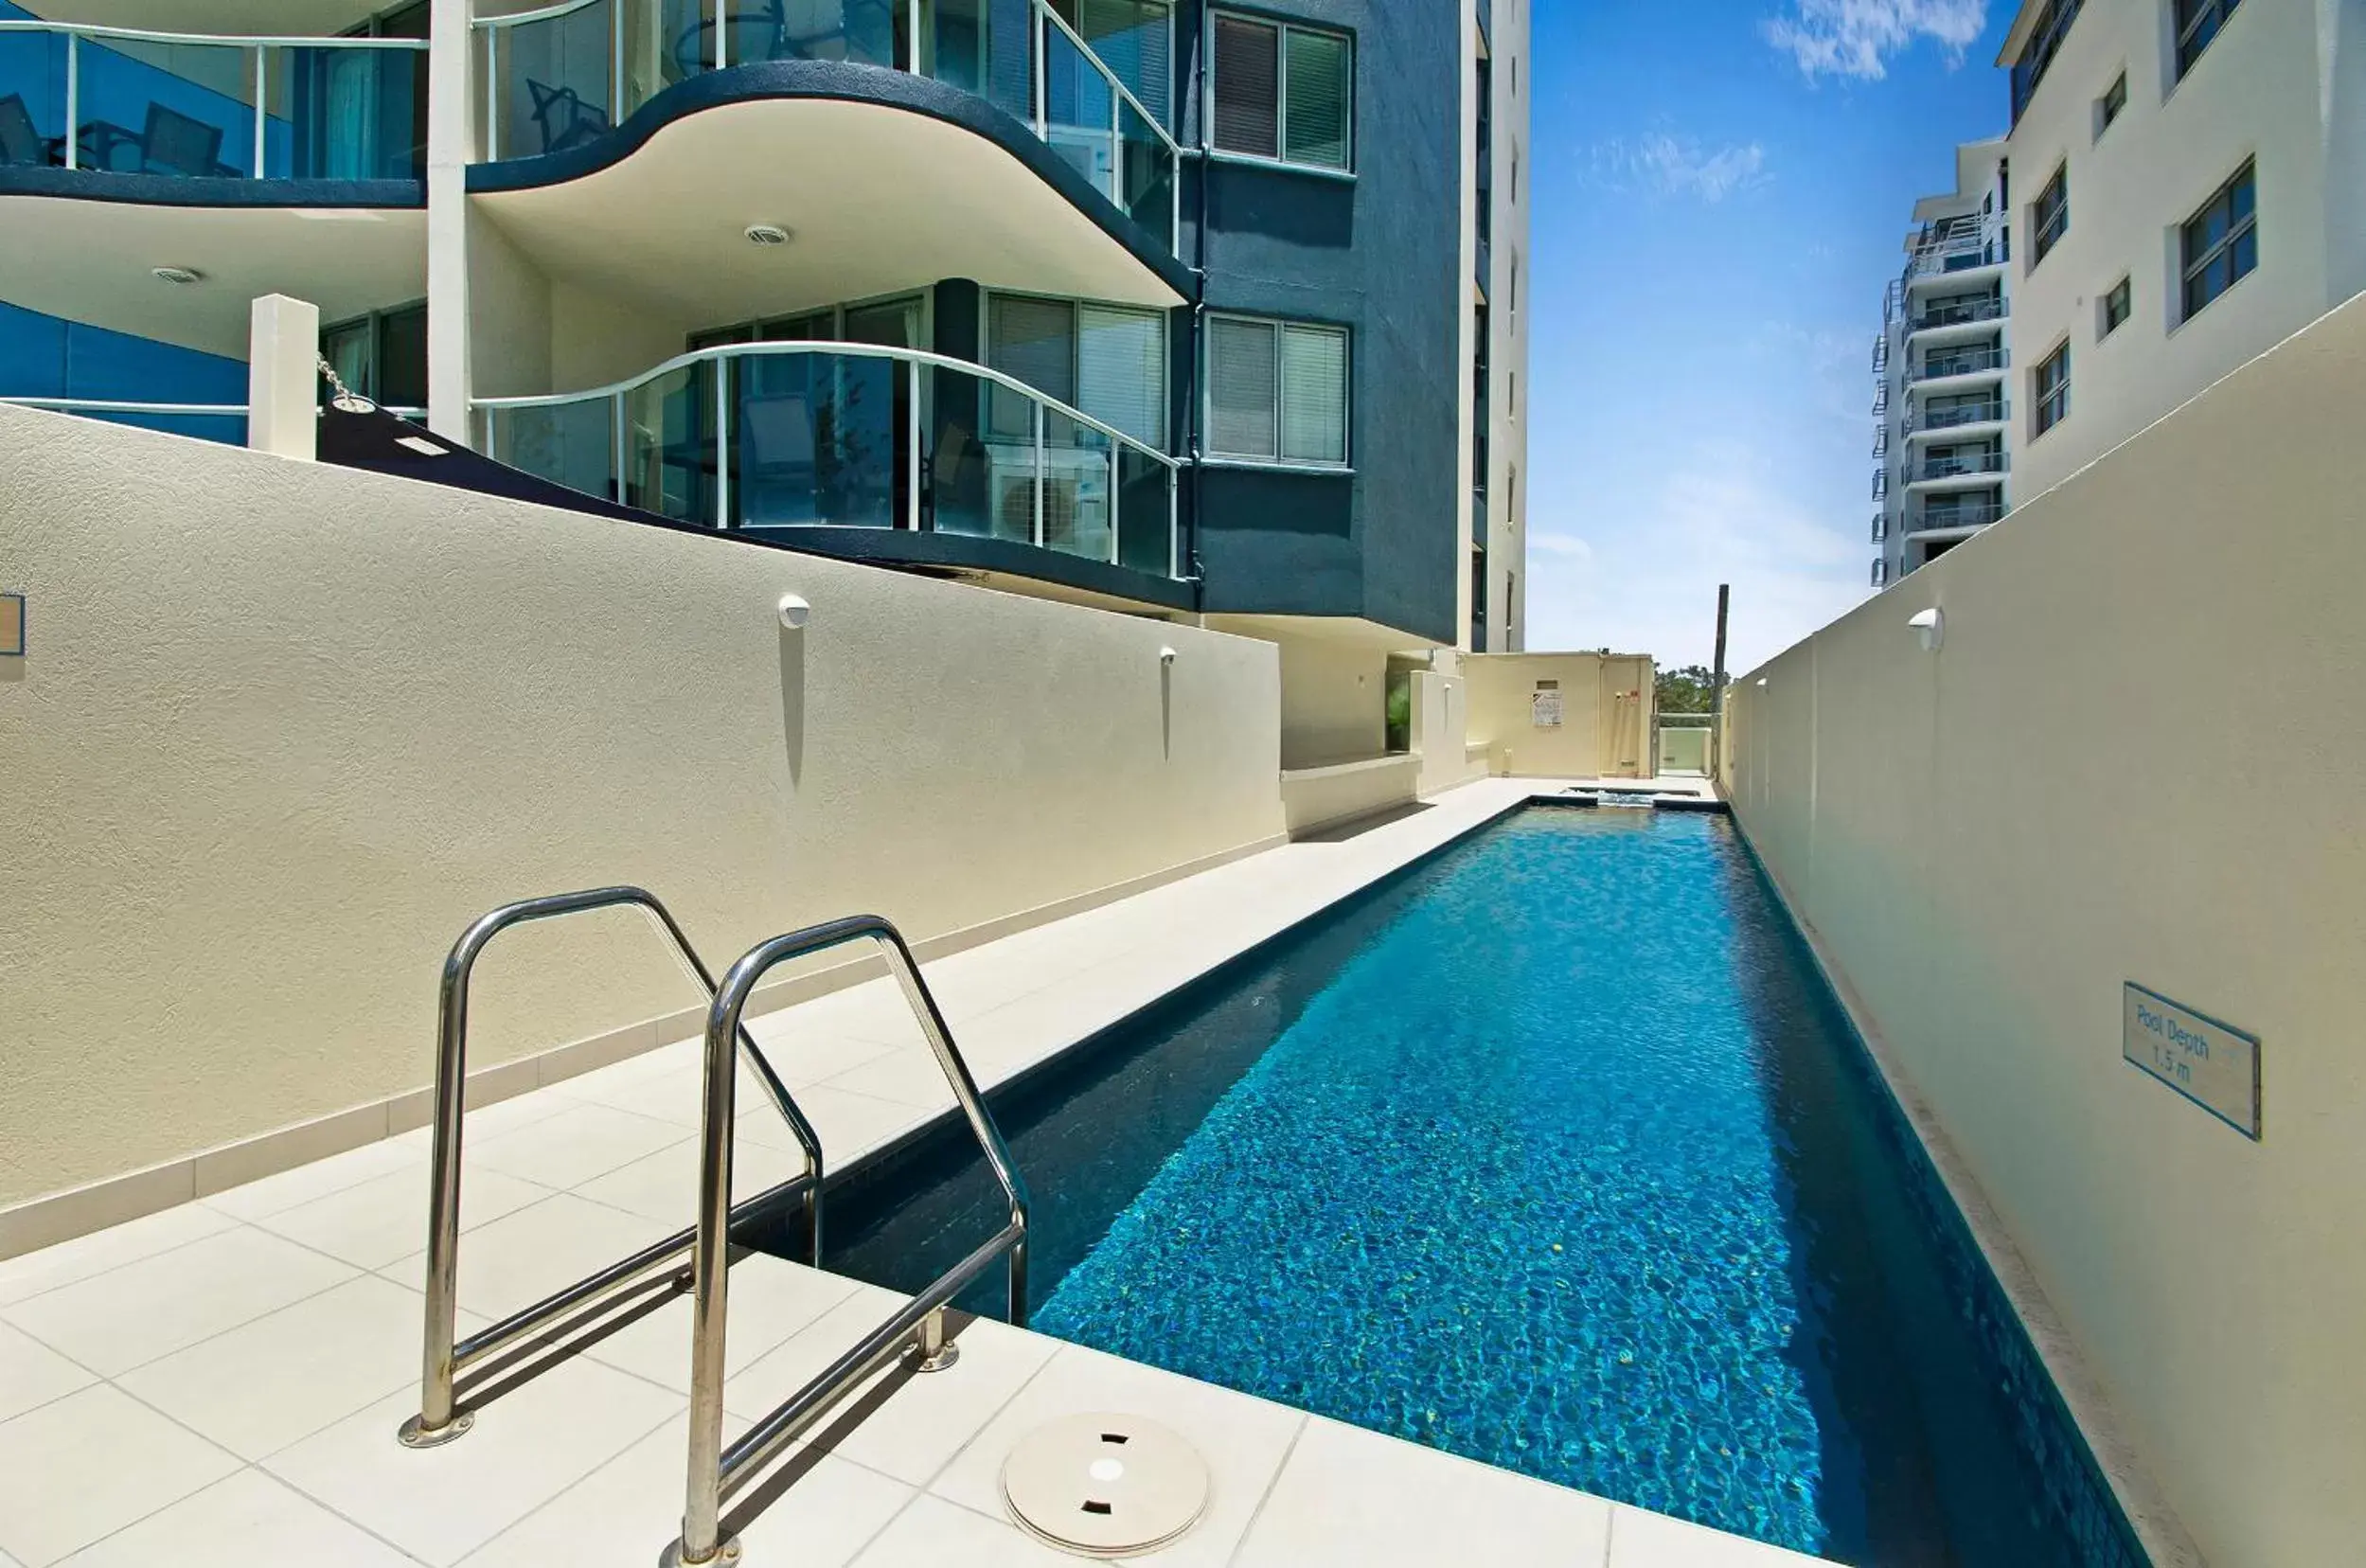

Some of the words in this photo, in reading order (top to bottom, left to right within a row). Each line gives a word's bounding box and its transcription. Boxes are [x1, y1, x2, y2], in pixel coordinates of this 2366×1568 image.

[2137, 1004, 2162, 1036] Pool
[2168, 1019, 2209, 1060] Depth
[2153, 1045, 2173, 1072] 1.5
[2177, 1062, 2190, 1082] m
